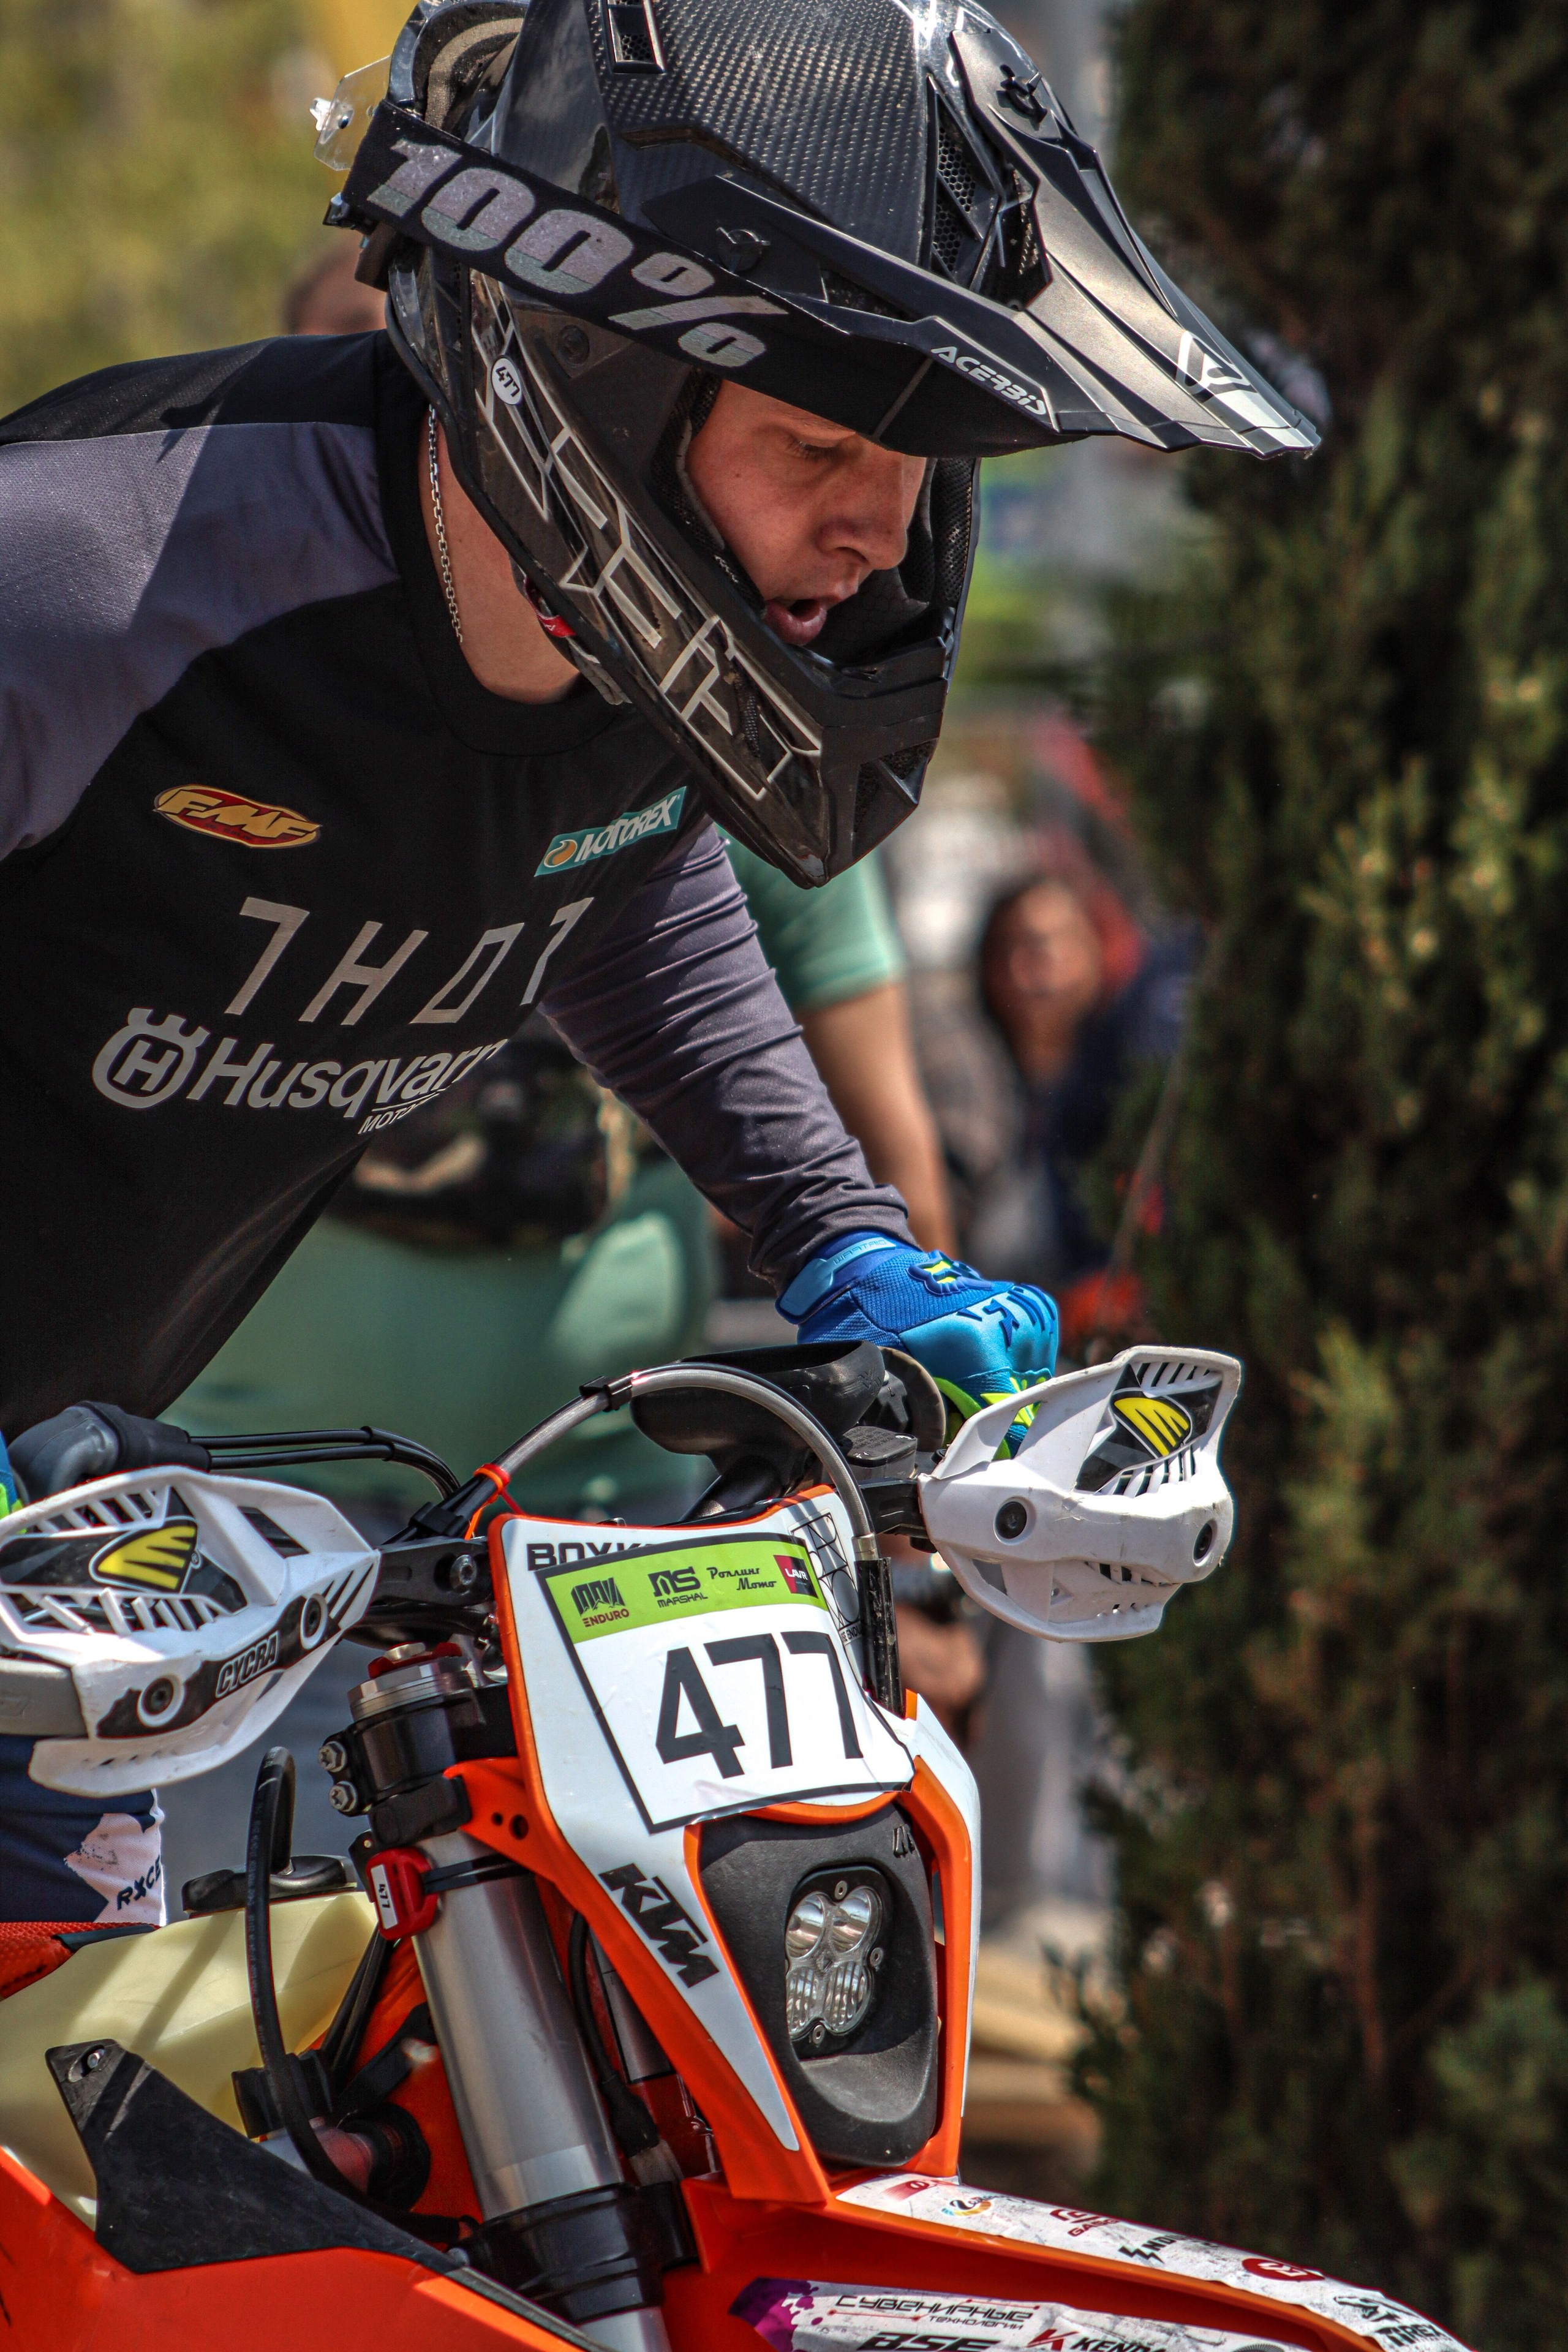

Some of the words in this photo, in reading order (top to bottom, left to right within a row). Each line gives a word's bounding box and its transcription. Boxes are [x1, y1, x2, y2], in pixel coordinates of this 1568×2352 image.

[367, 138, 789, 368] 100%
[495, 366, 521, 399] 477
[154, 789, 321, 839] FMF
[574, 795, 677, 863] MOTOREX
[657, 1592, 708, 1608] MARSHAL
[785, 1568, 808, 1580] LAVR
[582, 1608, 630, 1628] ENDURO
[215, 1630, 280, 1698] CYCRA
[655, 1631, 864, 1779] 477
[598, 1863, 720, 1989] KTM
